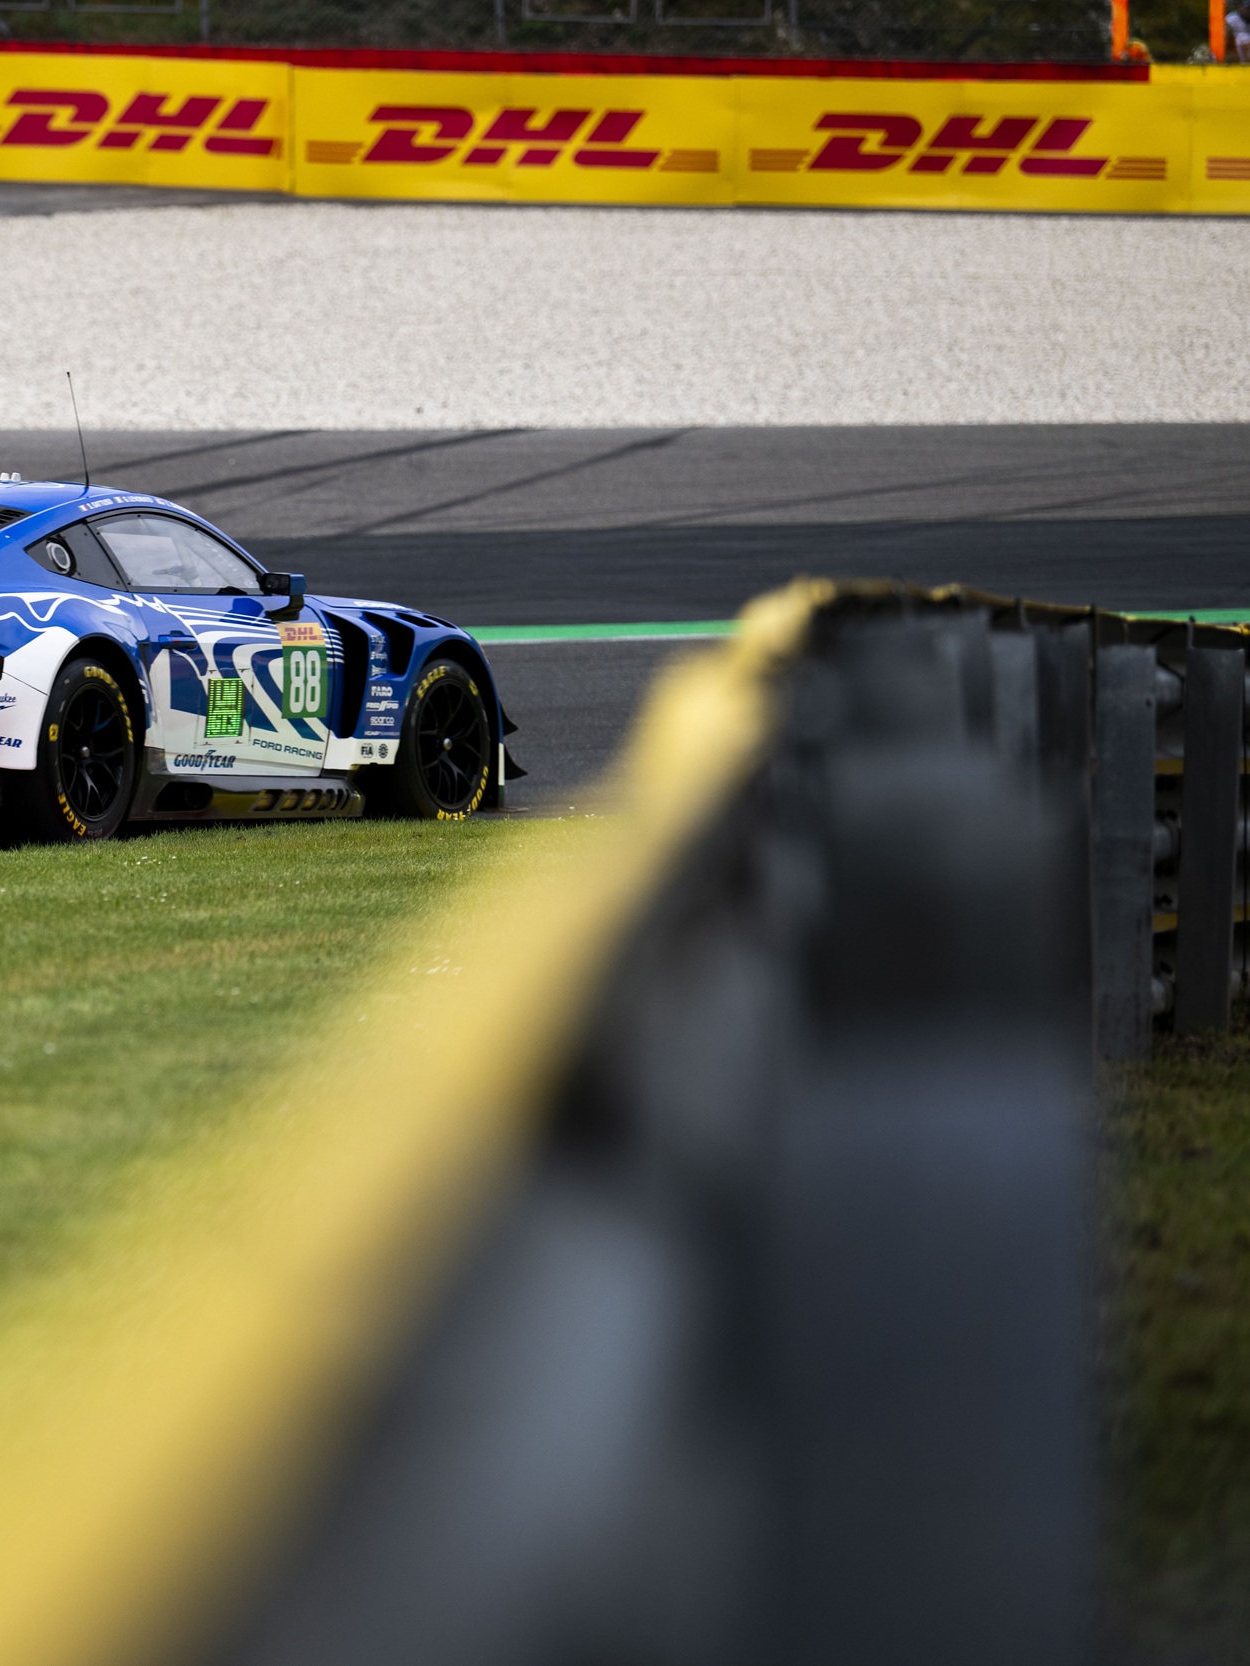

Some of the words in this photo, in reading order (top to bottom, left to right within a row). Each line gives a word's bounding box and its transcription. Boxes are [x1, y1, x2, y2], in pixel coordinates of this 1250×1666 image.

[0, 88, 277, 157] DHL
[362, 104, 660, 169] DHL
[808, 112, 1109, 178] DHL
[284, 627, 318, 641] DHL
[289, 650, 321, 714] 88
[370, 685, 394, 697] FARO
[416, 665, 446, 700] EAGLE
[370, 716, 395, 726] sparco
[173, 749, 237, 771] GOODYEAR
[252, 738, 283, 752] FORD
[283, 745, 323, 760] RACING
[361, 745, 374, 756] FIA
[58, 792, 87, 837] EAGLE
